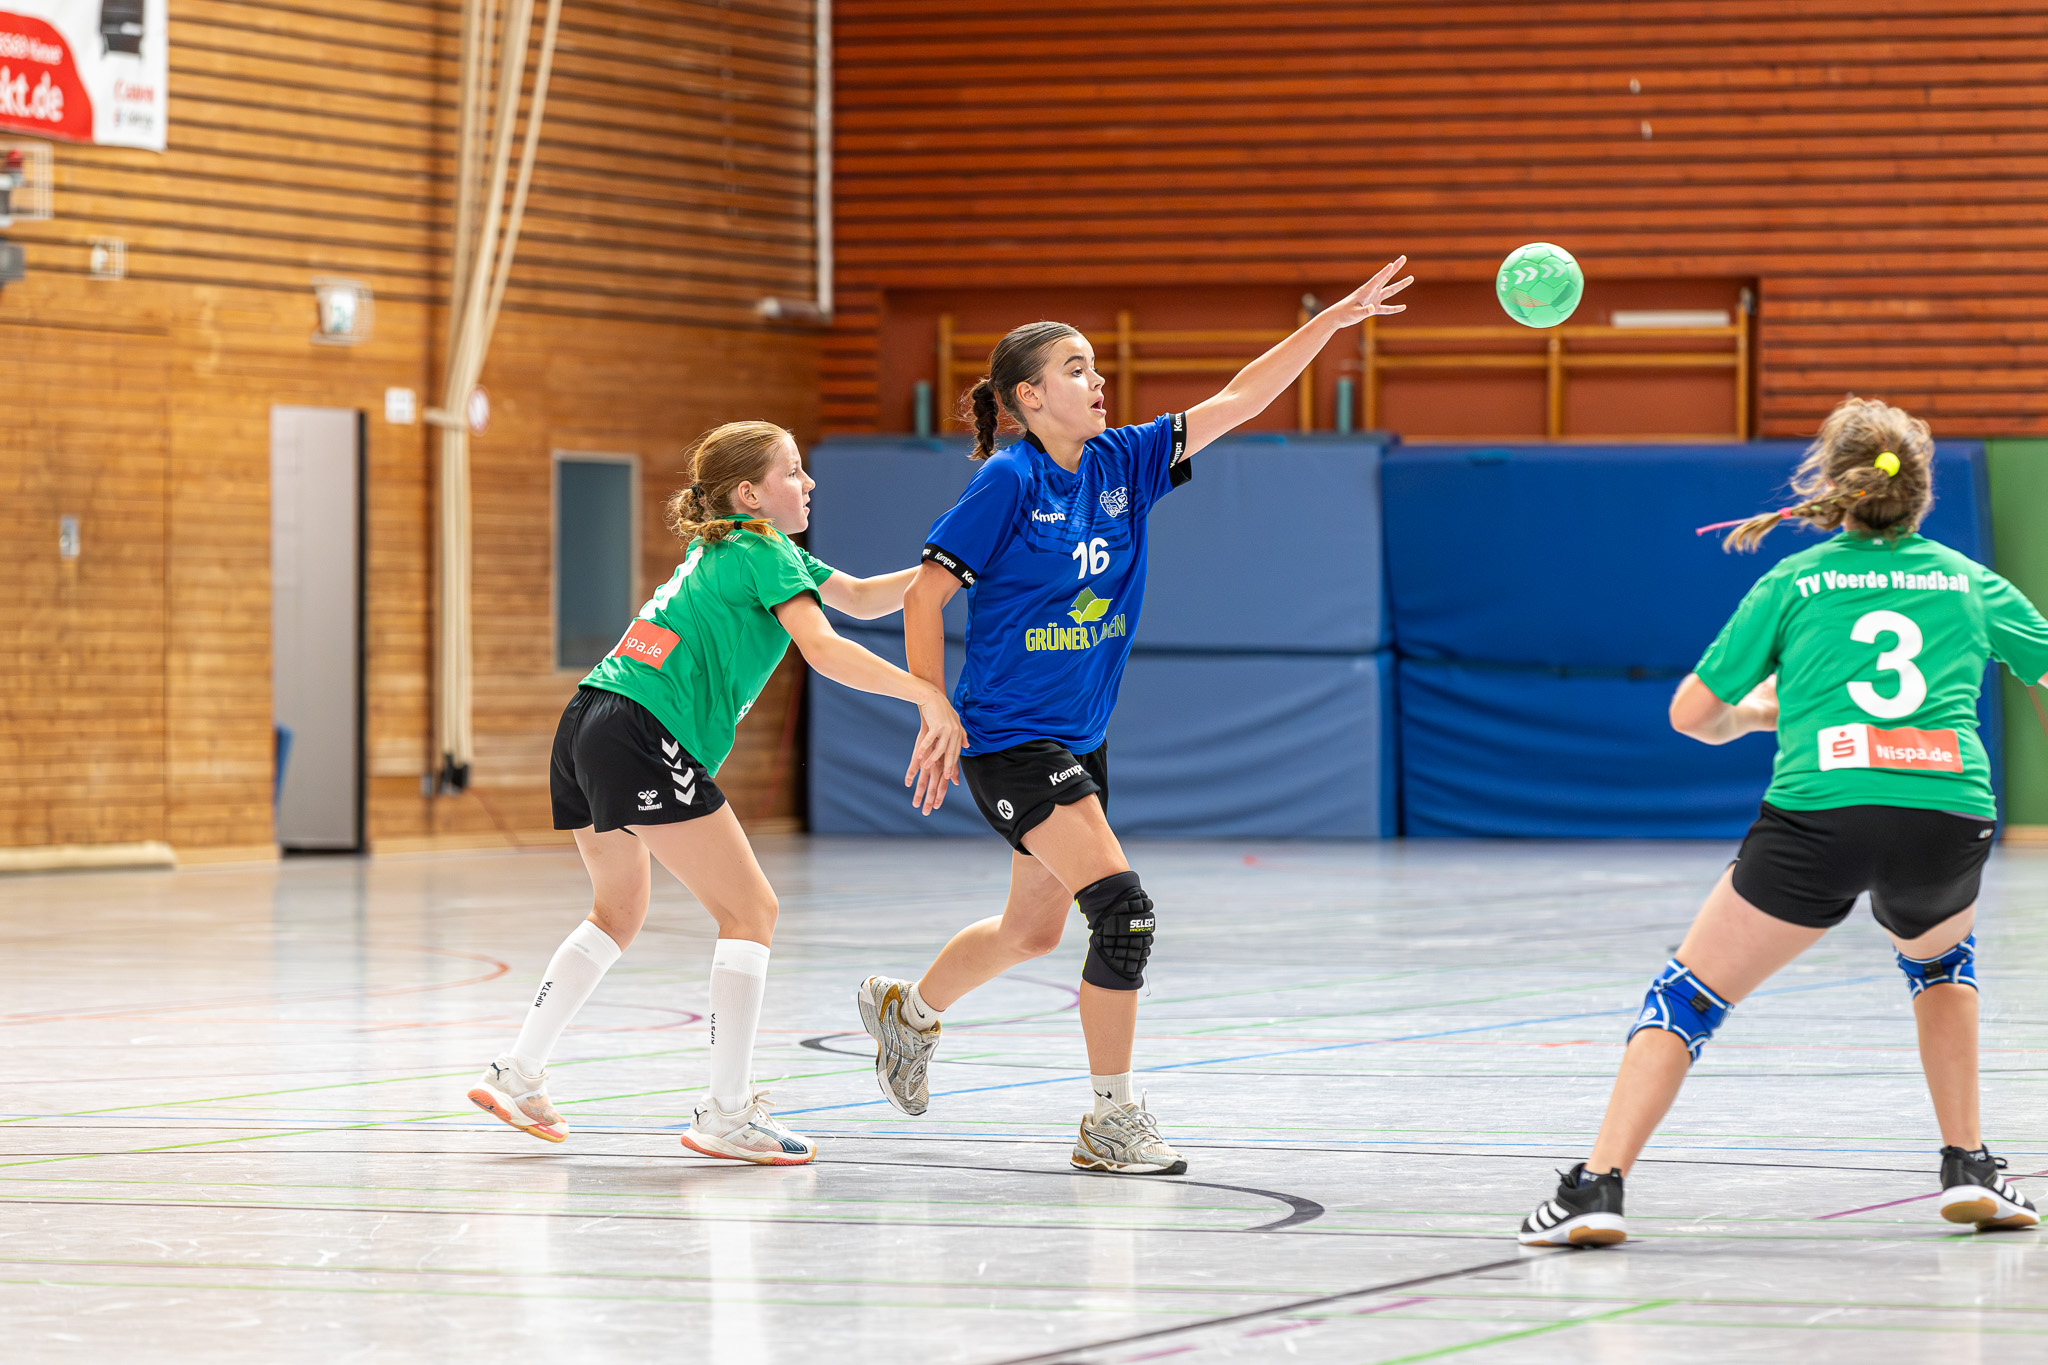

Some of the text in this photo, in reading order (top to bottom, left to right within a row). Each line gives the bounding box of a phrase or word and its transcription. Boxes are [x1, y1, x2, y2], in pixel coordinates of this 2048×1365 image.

[0, 65, 64, 123] kt.de
[1173, 412, 1183, 432] Kem
[1032, 508, 1066, 524] Kmpa
[934, 551, 957, 570] Kmpa
[1072, 537, 1110, 580] 16
[1795, 569, 1970, 598] TV Voerde Handball
[624, 636, 663, 658] spa.de
[1025, 622, 1091, 652] GRÜNER
[1846, 609, 1927, 719] 3
[1875, 744, 1953, 763] Nispa.de
[637, 801, 663, 811] hummel
[534, 981, 554, 1008] KIPSTA
